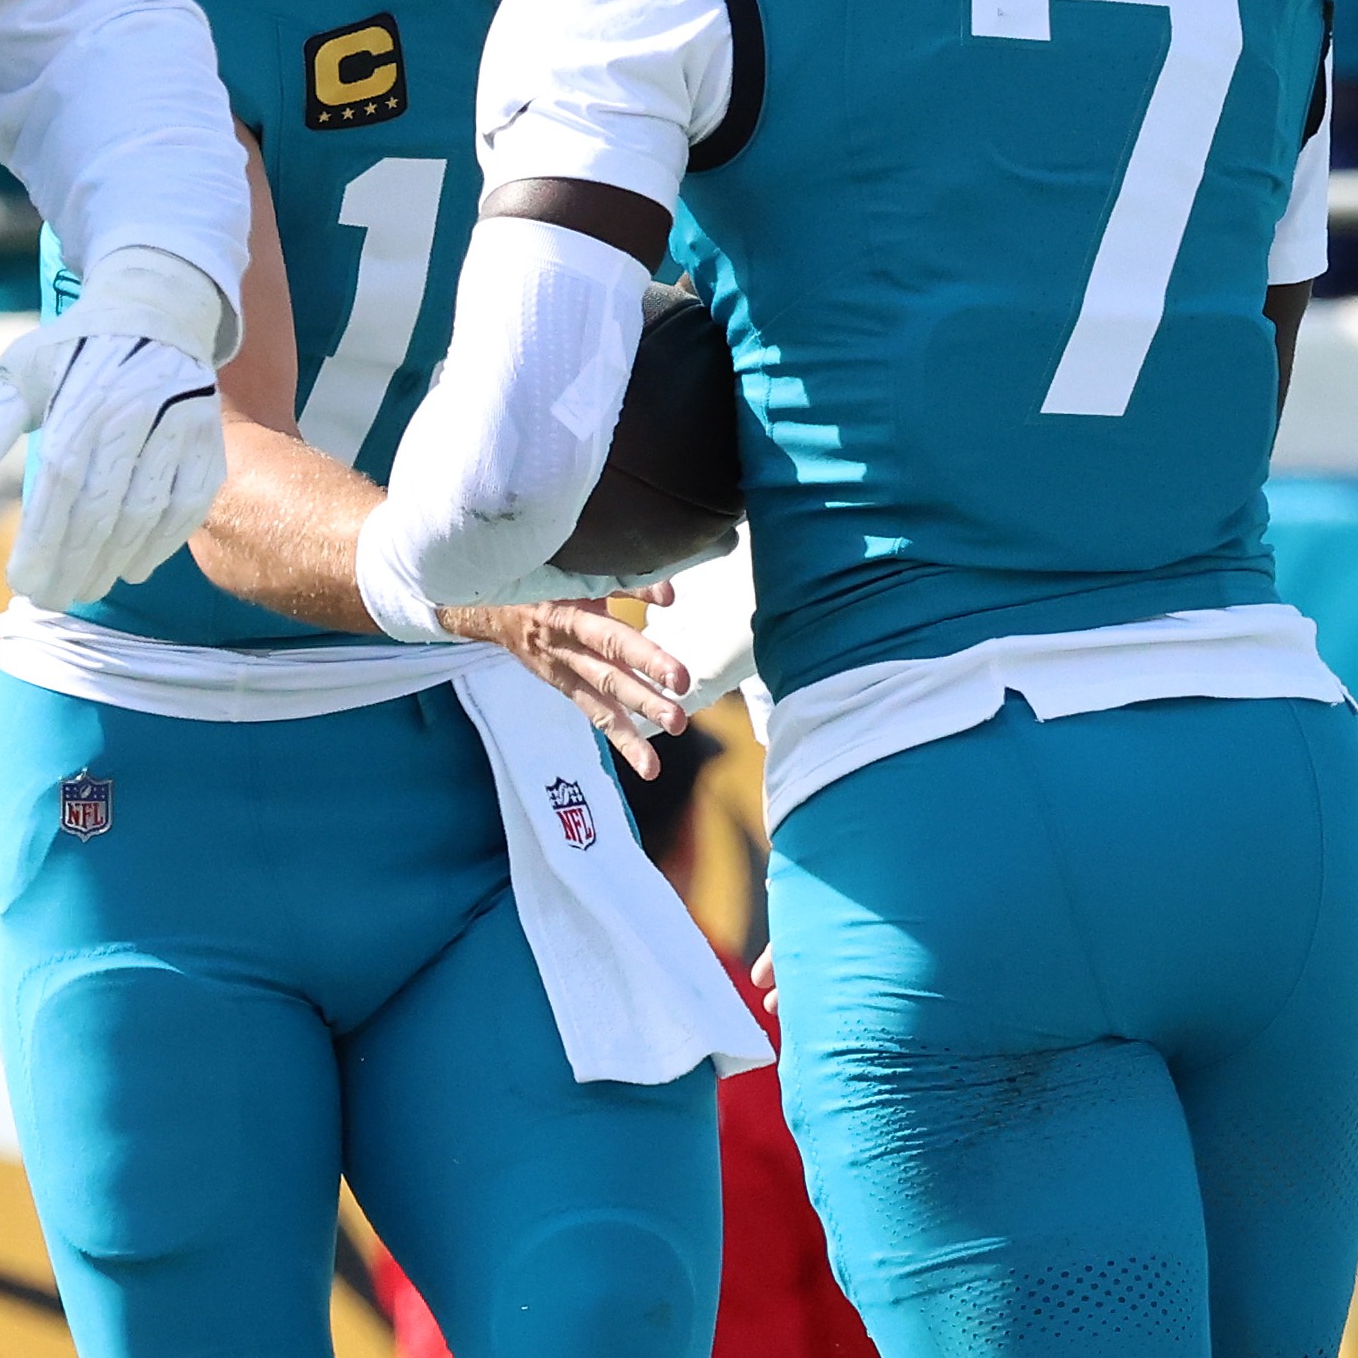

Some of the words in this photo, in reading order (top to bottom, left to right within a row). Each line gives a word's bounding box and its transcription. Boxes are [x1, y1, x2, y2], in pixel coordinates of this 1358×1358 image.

[314, 25, 398, 107] C
[296, 156, 448, 470] 1
[67, 802, 104, 830] NFL
[555, 807, 593, 845] NFL
